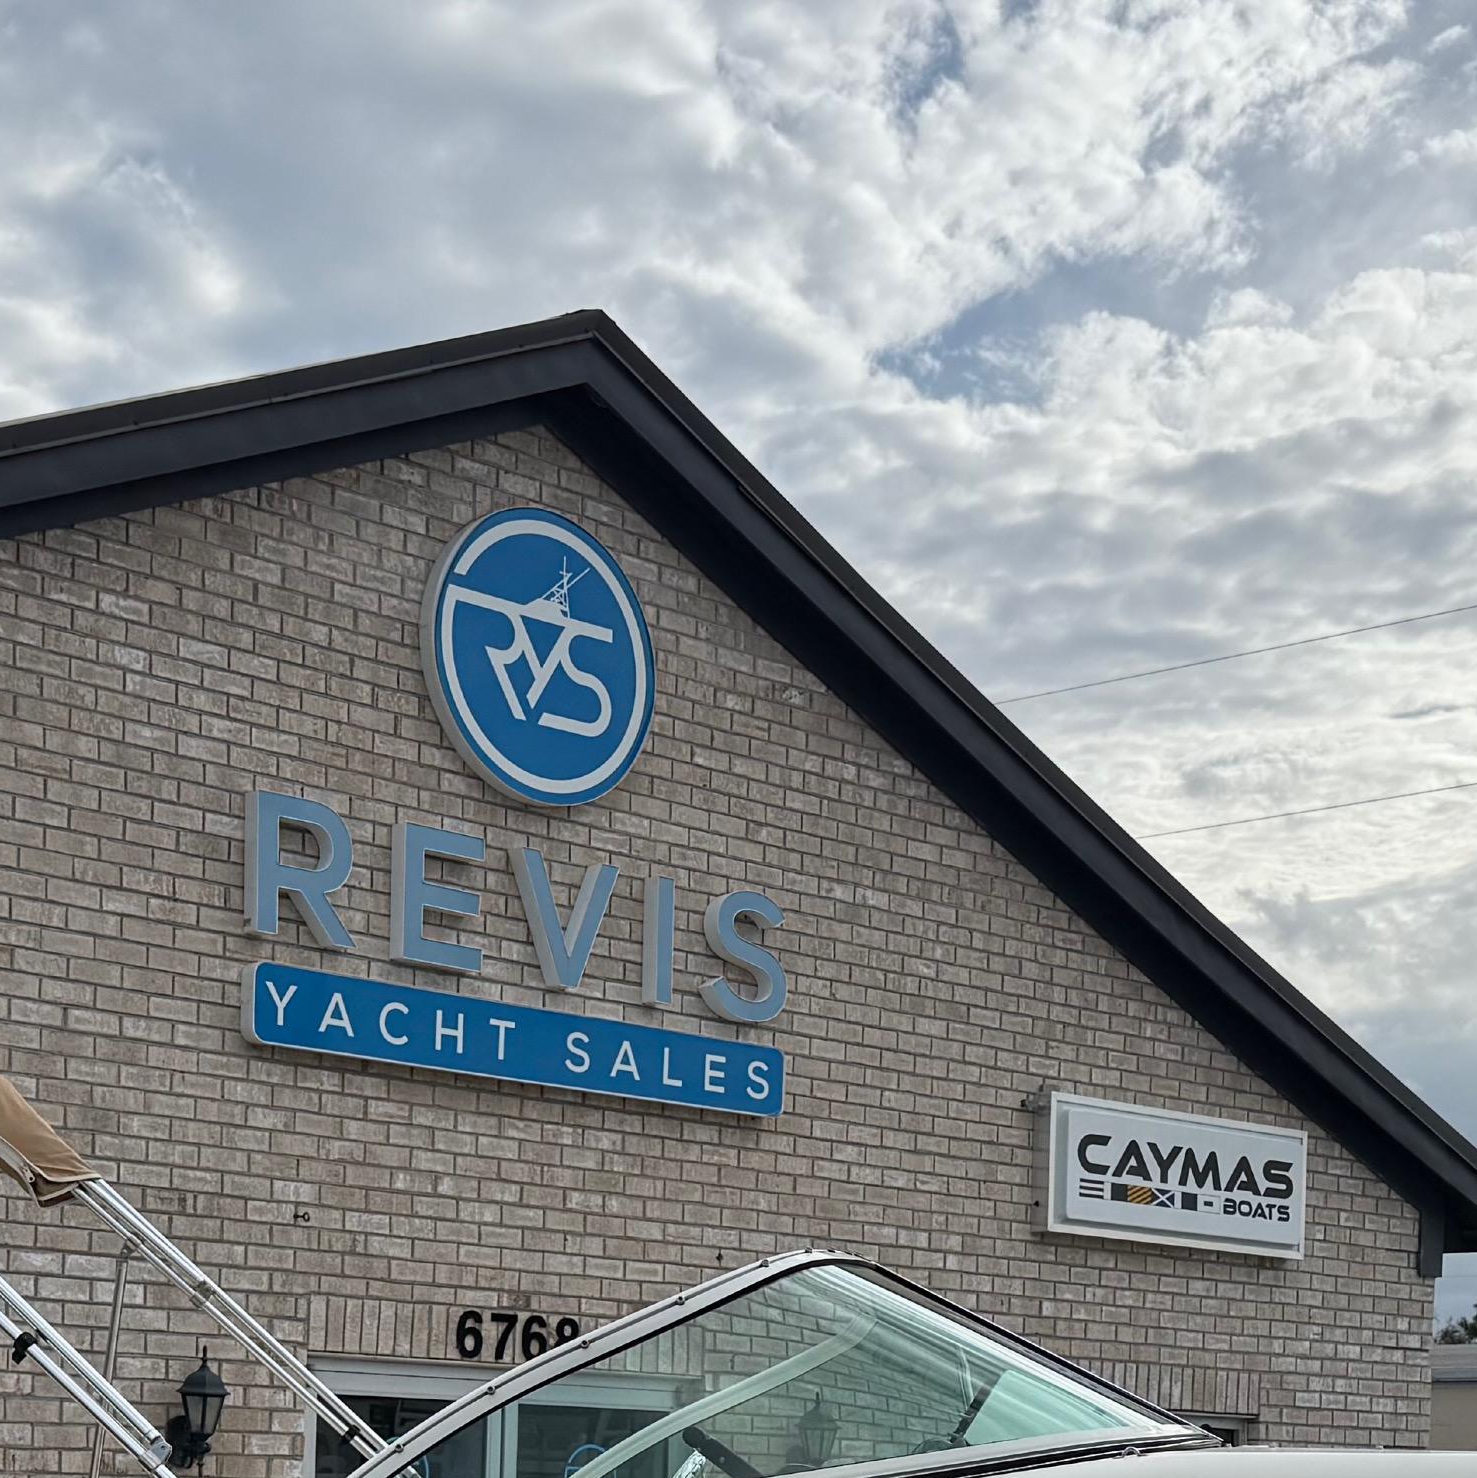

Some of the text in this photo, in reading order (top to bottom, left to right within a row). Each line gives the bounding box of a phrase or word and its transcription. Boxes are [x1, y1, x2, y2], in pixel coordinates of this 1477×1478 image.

[243, 790, 787, 1023] REVIS
[265, 981, 770, 1100] YACHT SALES
[1077, 1134, 1294, 1199] CAYMAS
[1223, 1198, 1291, 1222] BOATS
[456, 1310, 579, 1361] 6768
